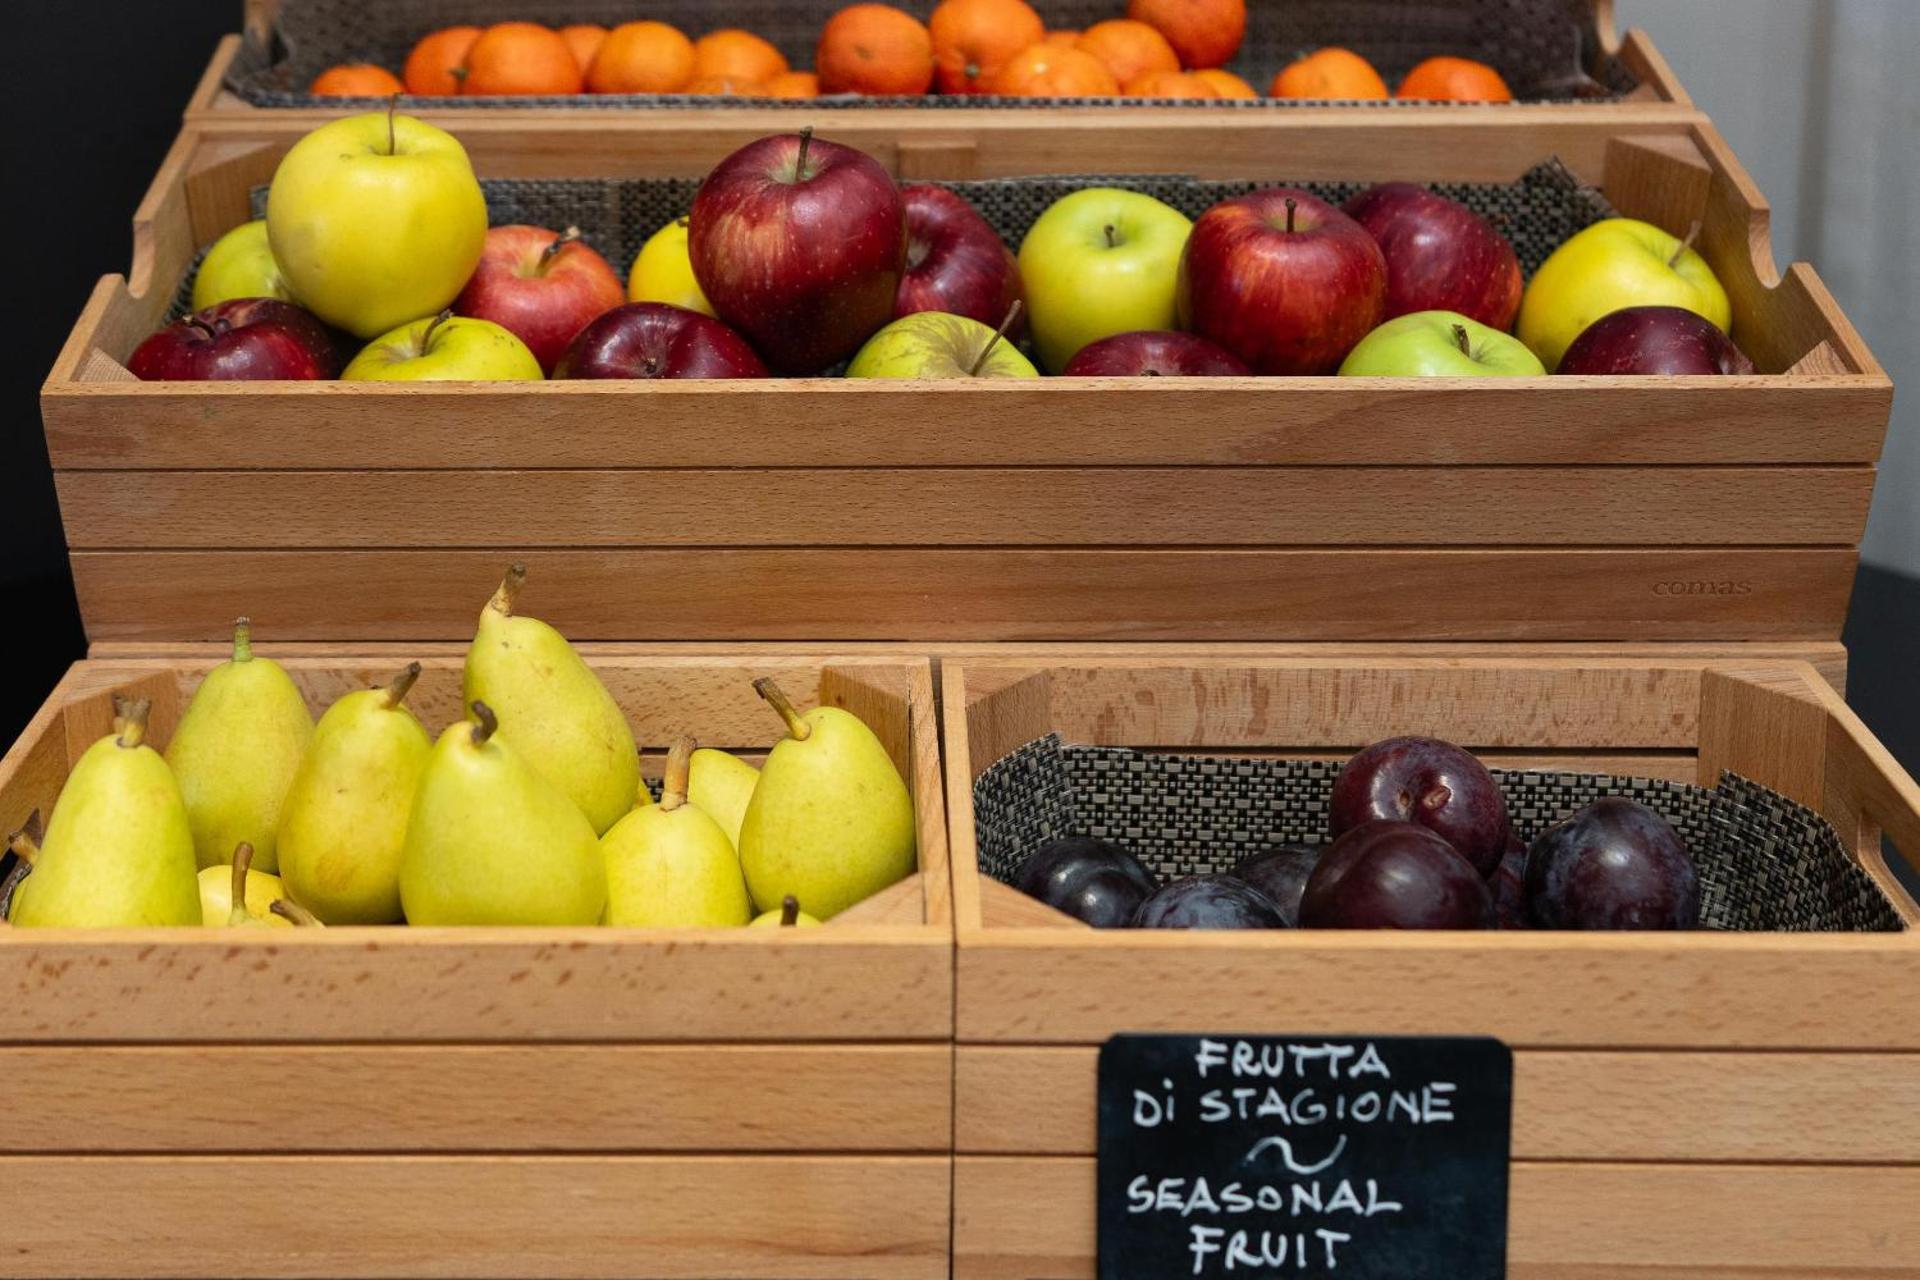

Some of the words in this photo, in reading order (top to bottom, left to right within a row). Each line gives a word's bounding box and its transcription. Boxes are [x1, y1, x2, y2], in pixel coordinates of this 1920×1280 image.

[1652, 580, 1752, 596] comas
[1195, 1039, 1390, 1079] FRUTTA
[1199, 1082, 1457, 1126] STAGIONE
[1127, 1175, 1402, 1217] SEASONAL
[1188, 1224, 1352, 1275] FRUIT
